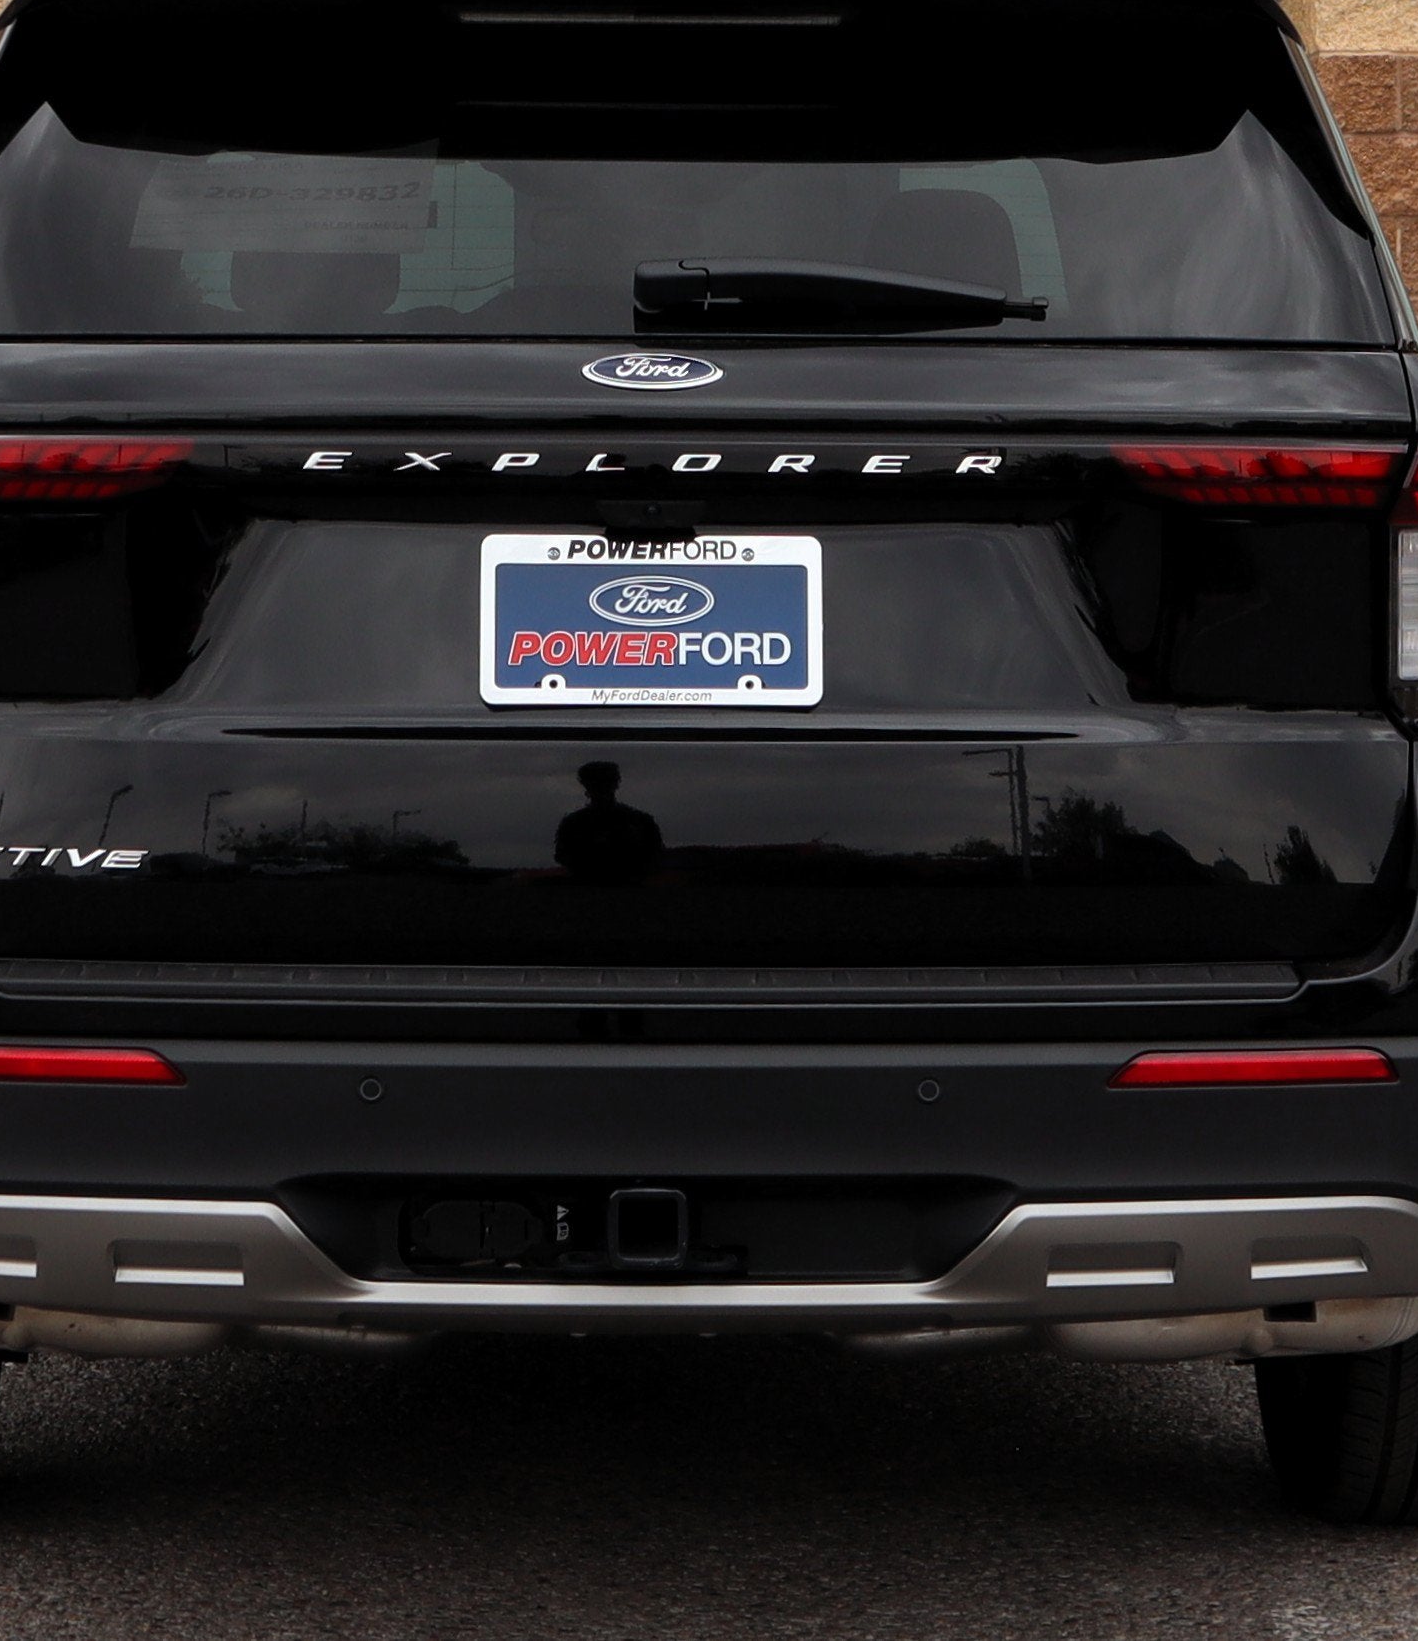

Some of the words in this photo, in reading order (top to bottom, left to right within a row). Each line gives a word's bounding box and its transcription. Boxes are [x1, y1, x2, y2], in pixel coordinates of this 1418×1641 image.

[615, 357, 691, 377] Ford
[302, 451, 1003, 474] EXPLORER
[567, 539, 737, 559] POWERFORD
[614, 584, 688, 615] Ford
[507, 630, 792, 666] POWERFORD
[591, 689, 712, 705] MyFordDealer.com
